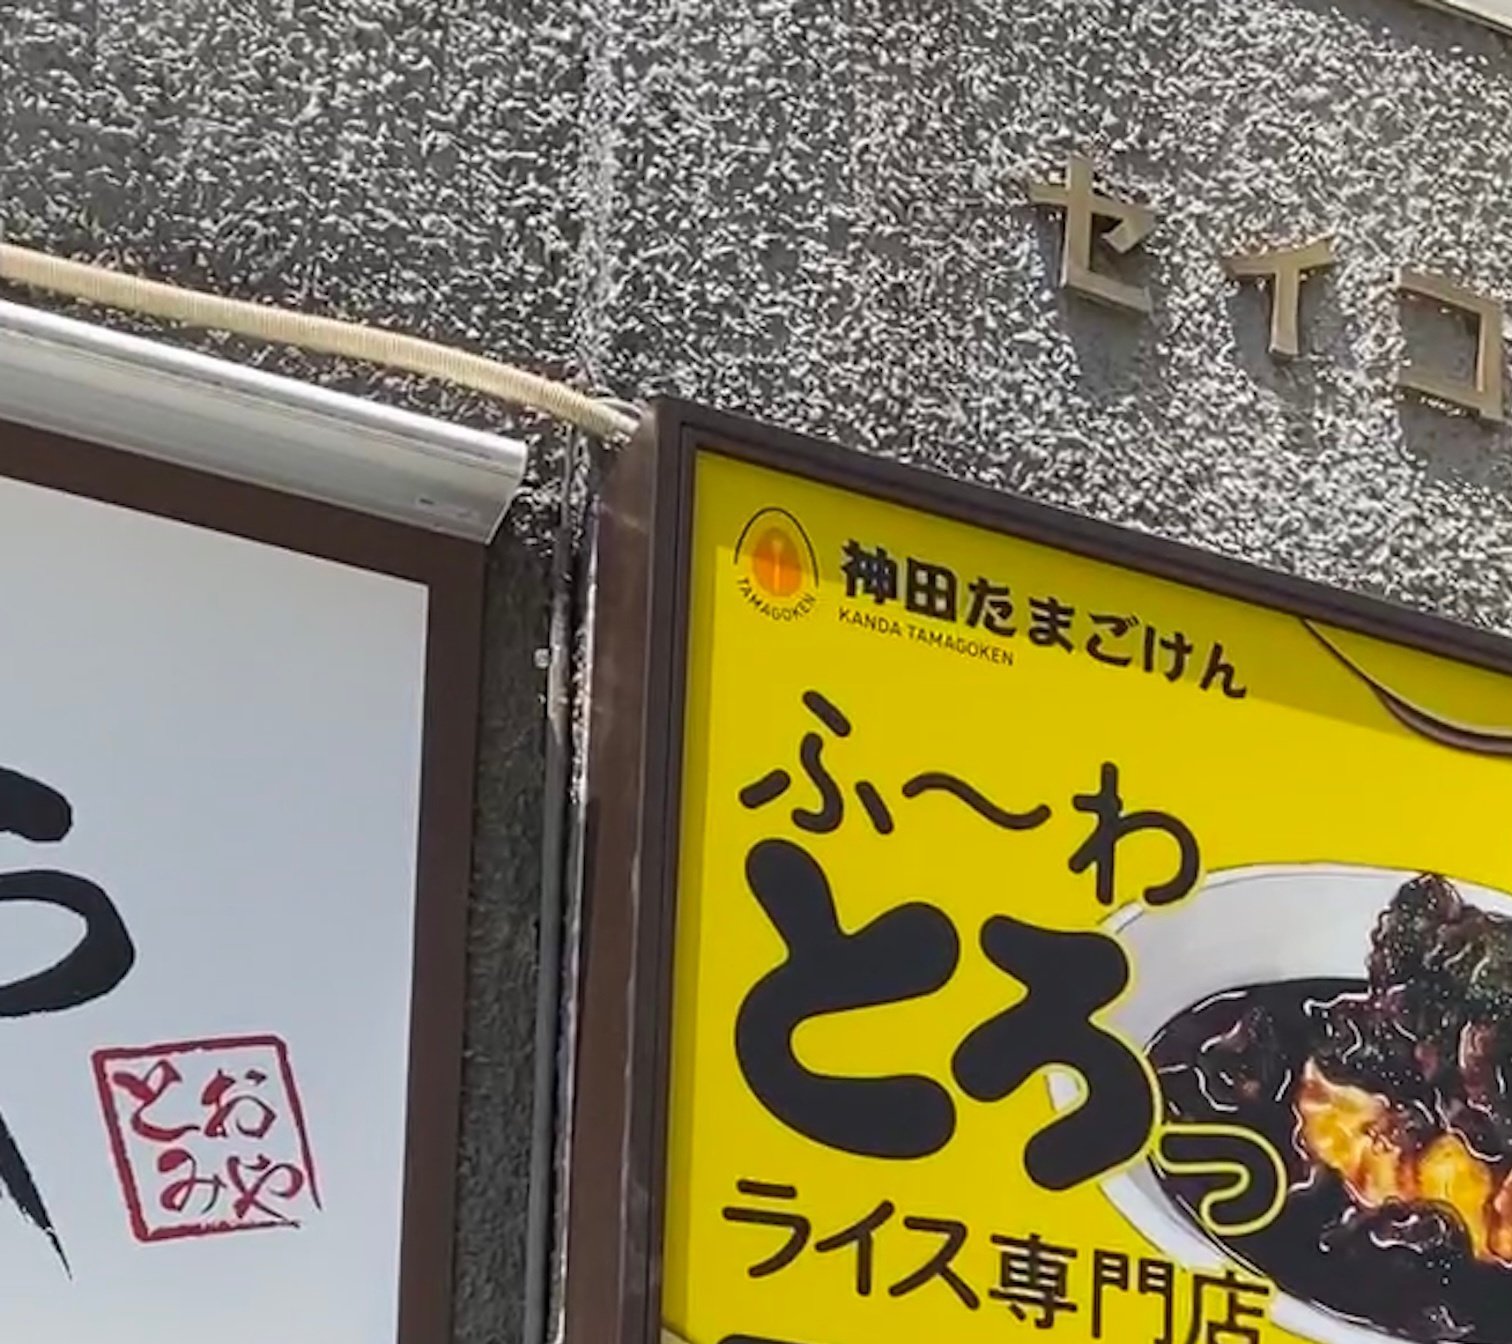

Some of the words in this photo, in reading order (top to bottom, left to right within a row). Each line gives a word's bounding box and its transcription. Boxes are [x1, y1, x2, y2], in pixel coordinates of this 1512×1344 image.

[838, 606, 902, 638] KANDA
[906, 623, 1014, 667] TAMAGOKEN
[841, 538, 1247, 699] 神田たまごけん
[733, 838, 1288, 1236] とろっ
